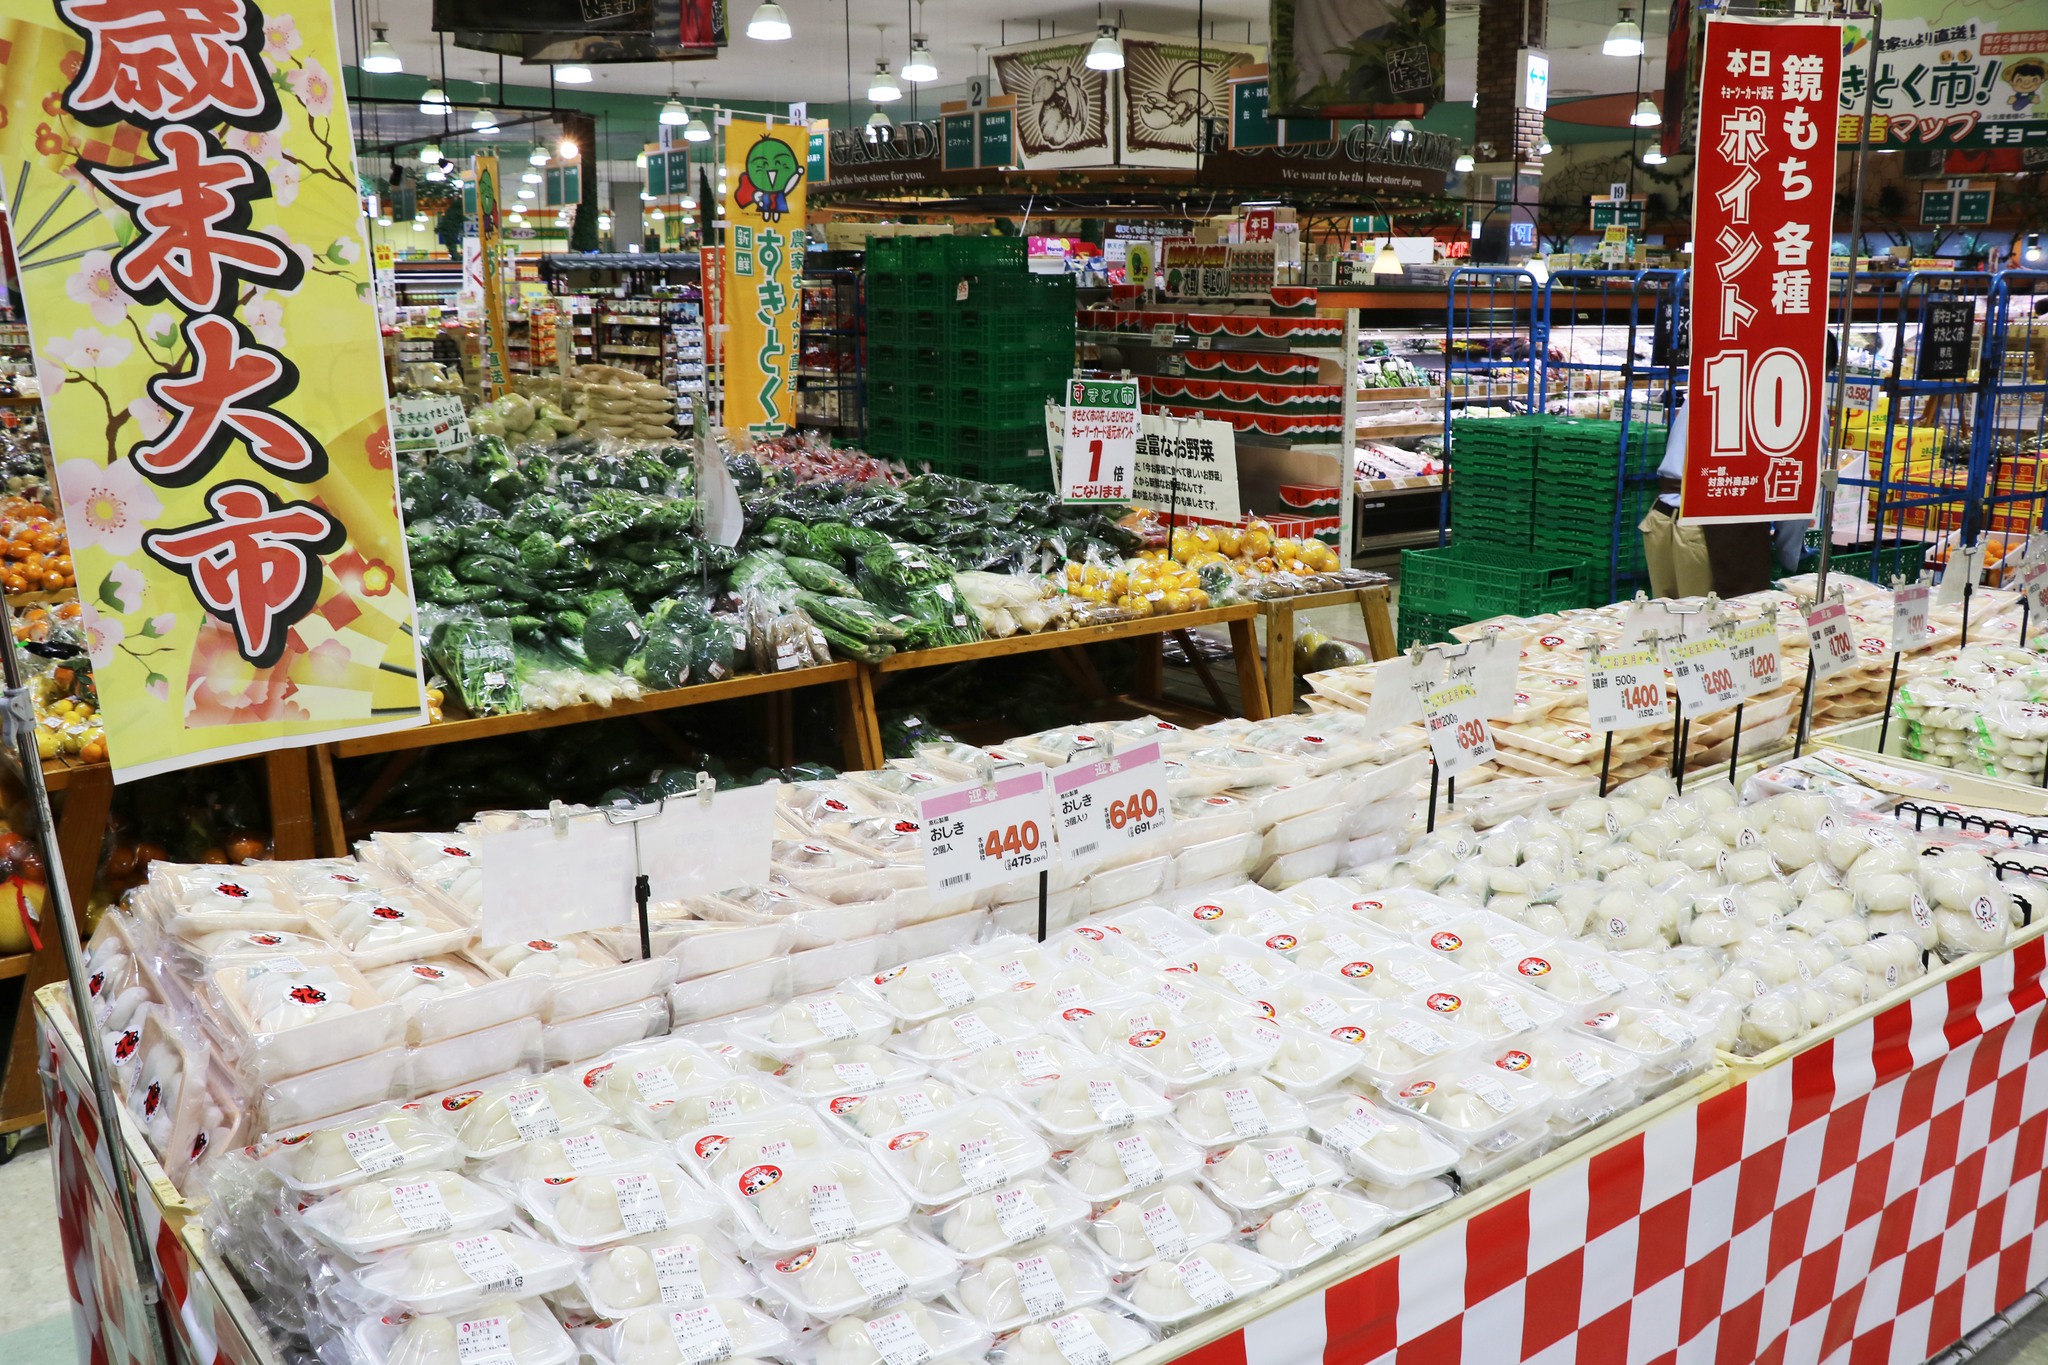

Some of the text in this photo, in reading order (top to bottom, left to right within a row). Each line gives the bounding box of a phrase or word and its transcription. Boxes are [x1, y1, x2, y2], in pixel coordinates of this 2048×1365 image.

[1726, 48, 1771, 77] 本日
[971, 81, 982, 106] 2
[662, 128, 670, 147] 4
[854, 174, 868, 182] best
[869, 174, 889, 182] store
[890, 171, 903, 180] for
[905, 171, 925, 182] you.
[1282, 169, 1299, 179] We
[1301, 170, 1326, 180] want
[1327, 170, 1337, 180] to
[1339, 171, 1350, 181] be
[1367, 173, 1383, 183] best
[1383, 175, 1401, 185] store
[1771, 54, 1824, 314] 鏡もち 各種
[1613, 186, 1624, 199] 19
[1251, 216, 1269, 230] 本日
[1715, 105, 1769, 340] ポイント
[62, 0, 346, 668] 歳末大市
[1073, 382, 1135, 406] すきとく市
[1703, 346, 1811, 458] 10
[1088, 439, 1103, 482] 1
[1113, 466, 1124, 482] 倍
[1707, 475, 1758, 488] 対象外商品が
[1765, 458, 1802, 502] 倍
[1072, 485, 1127, 499] になります。
[1707, 486, 1747, 497] ございます
[1615, 675, 1636, 686] 500g
[1062, 794, 1092, 815] おしき
[1064, 813, 1088, 827] 3個入り
[930, 822, 964, 842] おしき
[932, 843, 953, 856] 2個入
